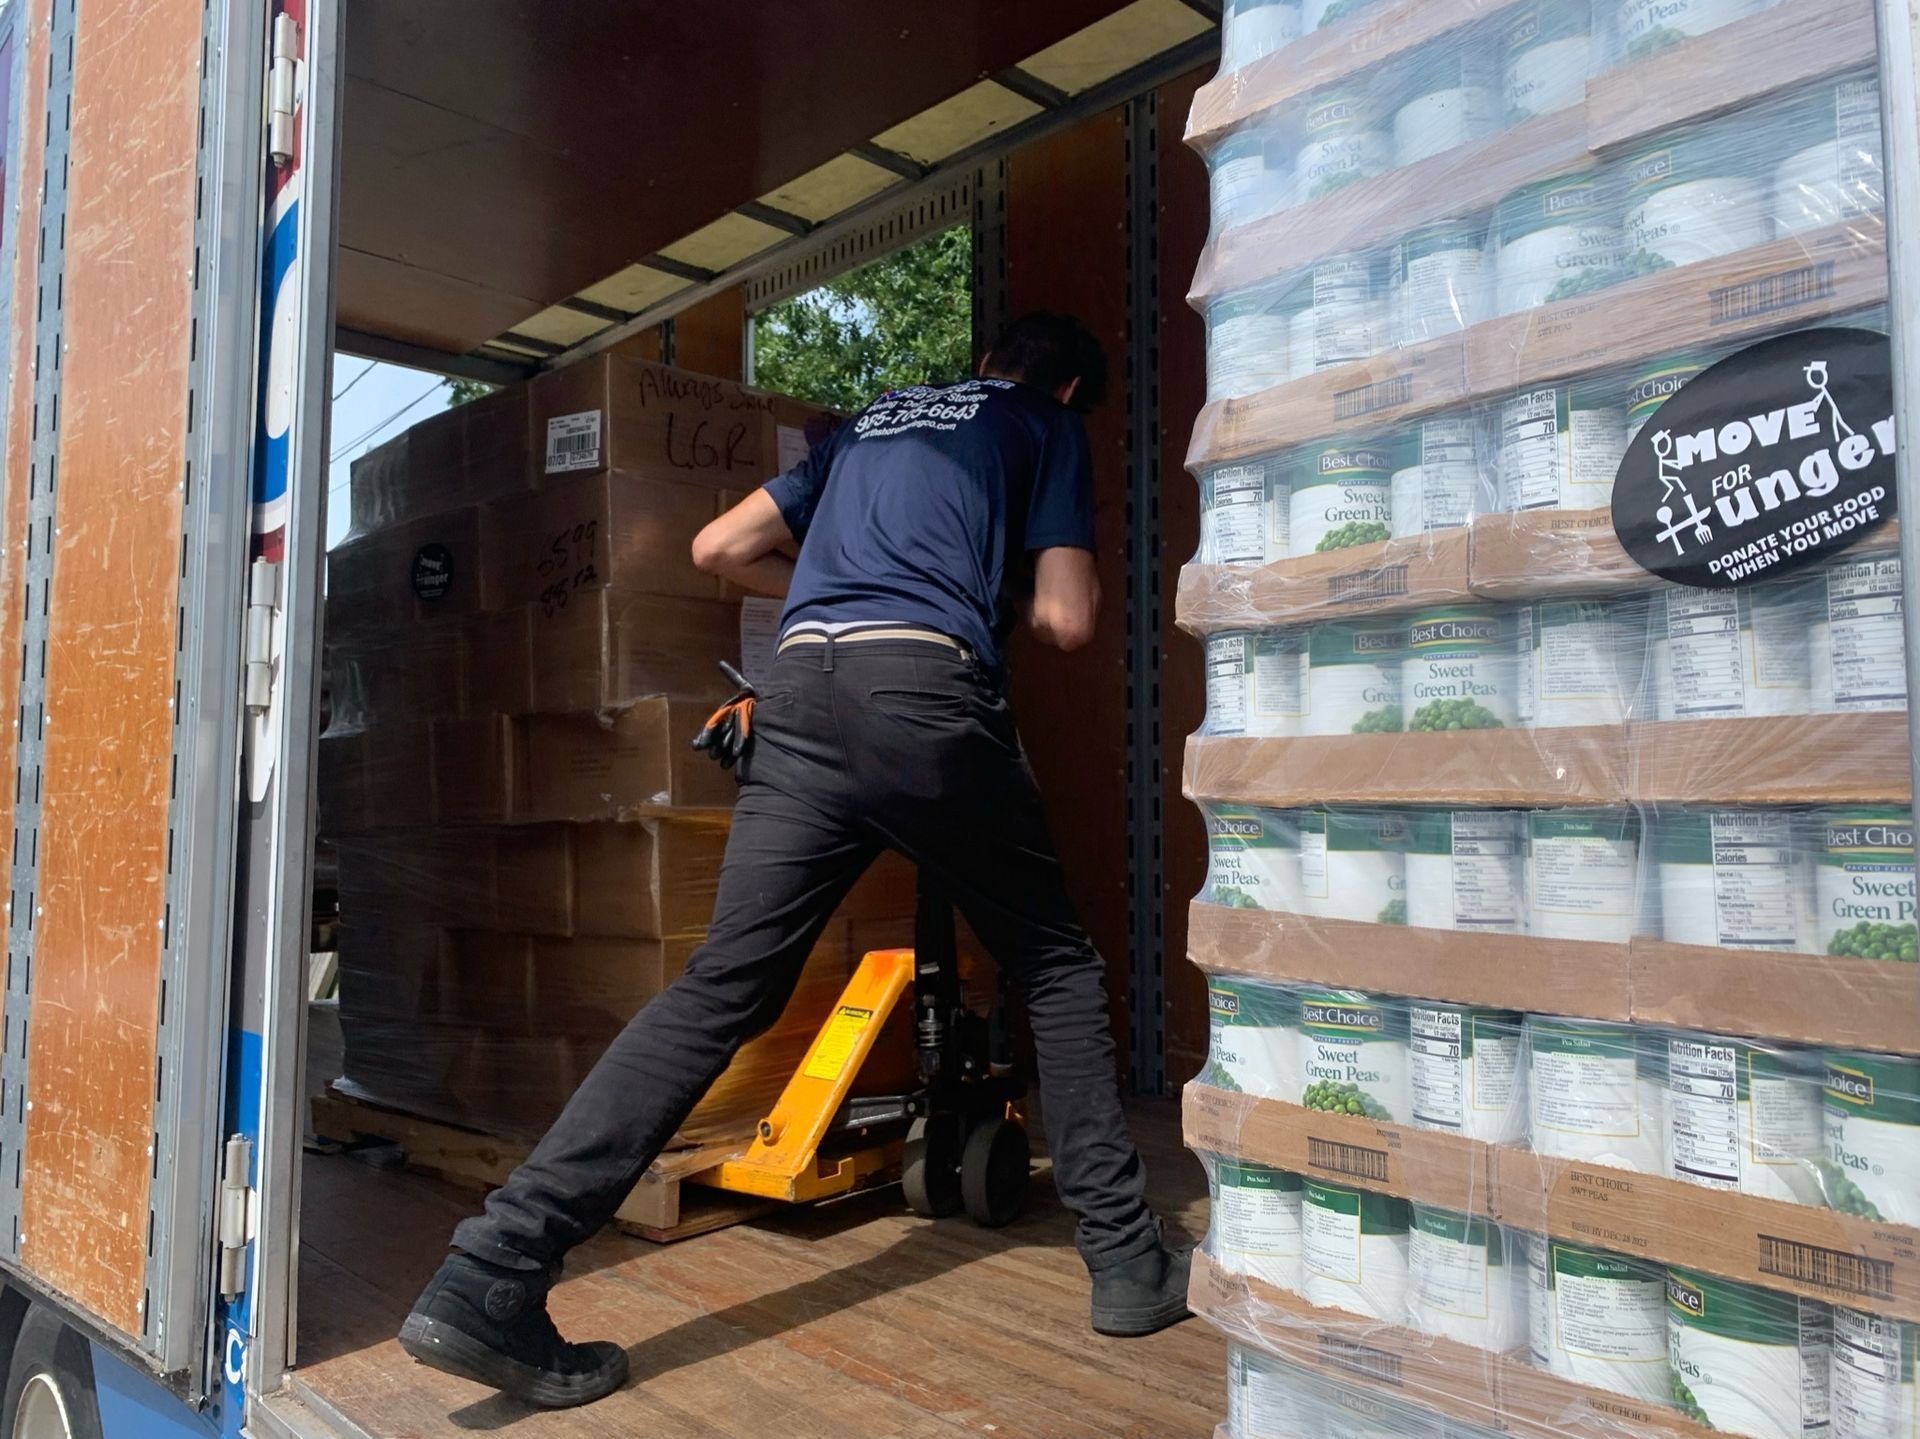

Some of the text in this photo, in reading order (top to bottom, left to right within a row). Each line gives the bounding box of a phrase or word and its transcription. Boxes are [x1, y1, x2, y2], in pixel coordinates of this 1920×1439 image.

[1641, 376, 1690, 398] Choic
[947, 391, 988, 403] Storage
[1531, 389, 1554, 405] Facts
[1542, 420, 1555, 434] 70
[1675, 400, 1821, 466] MOVE
[1322, 453, 1391, 470] Best Choi
[1711, 464, 1752, 496] FOR
[1252, 491, 1263, 502] 70
[1344, 488, 1385, 504] Sweet
[1325, 506, 1392, 522] Green Pe
[1551, 519, 1576, 529] BEST
[1708, 485, 1886, 574] DONATE YOUR FOOD
[1726, 505, 1880, 581] WHEN YOU MOVE
[1722, 617, 1737, 630] 70
[1410, 623, 1497, 643] Best Choice
[1233, 663, 1244, 674] 70
[1428, 662, 1475, 679] Sweet
[1413, 681, 1497, 699] Green Peas
[1218, 820, 1260, 835] Choice
[1713, 814, 1759, 827] Nutrition
[1827, 826, 1913, 847] Best Cho
[1213, 854, 1241, 869] Sweet
[1715, 853, 1748, 863] Calories
[1231, 870, 1261, 886] Peas
[1852, 875, 1916, 897] Sweet
[1832, 897, 1891, 920] Green
[1303, 1006, 1379, 1027] Best Choice
[1437, 1012, 1460, 1026] Facts
[1215, 1047, 1237, 1063] Peas
[1317, 1045, 1359, 1063] Sweet
[1448, 1044, 1460, 1057] 70
[1704, 1046, 1734, 1062] Facts
[1305, 1060, 1380, 1083] Green Peas
[1720, 1084, 1734, 1098] 70
[1834, 1143, 1869, 1171] Peas
[1570, 1170, 1634, 1193] BEST CHOICE
[1588, 1190, 1608, 1202] PEAS
[1868, 1317, 1898, 1339] Facts
[1673, 1348, 1700, 1378] Peas
